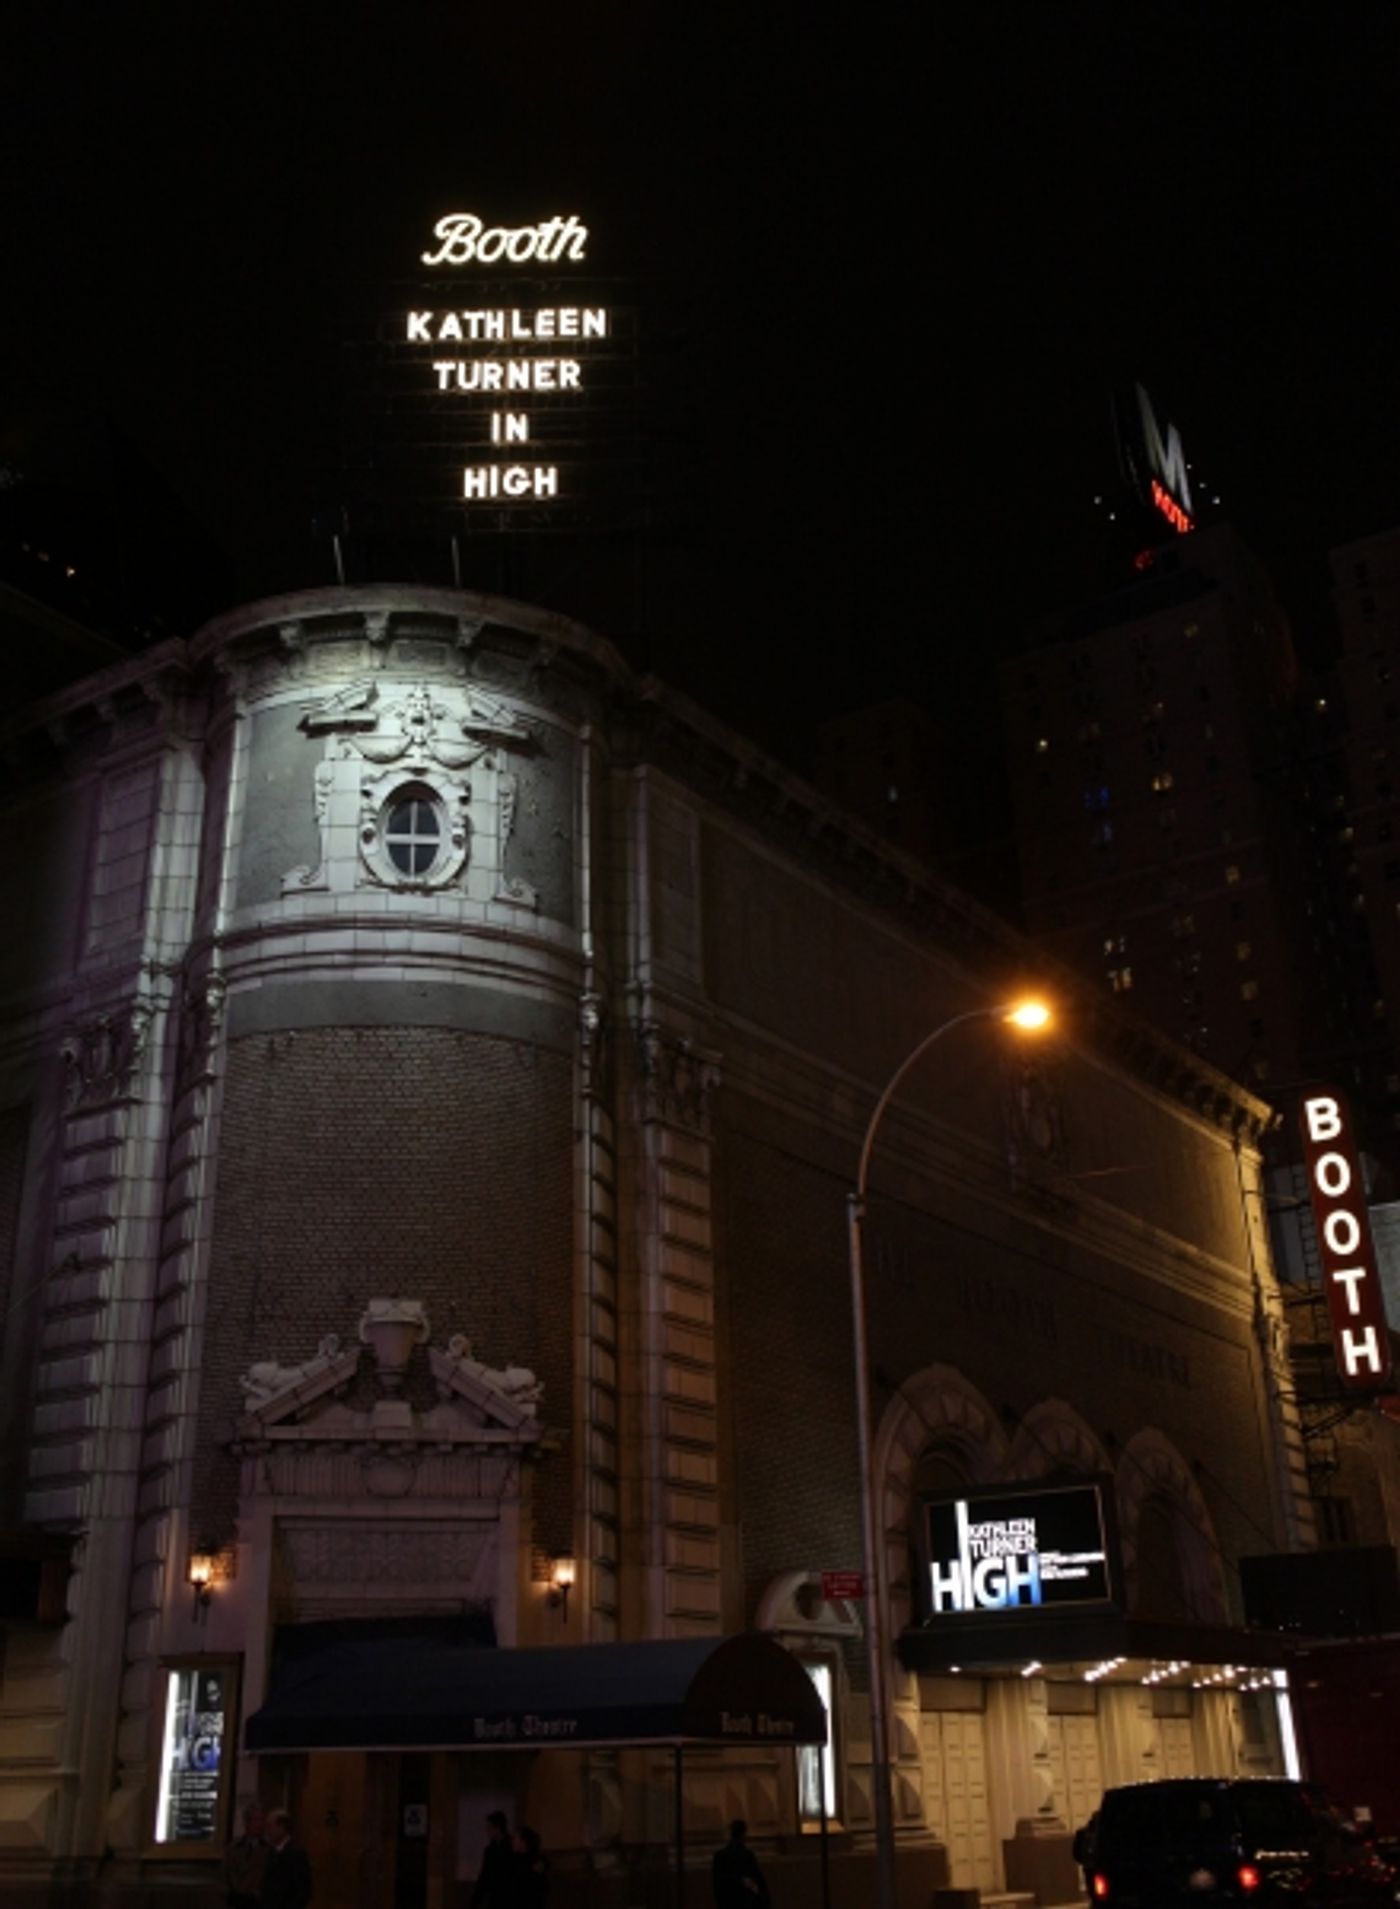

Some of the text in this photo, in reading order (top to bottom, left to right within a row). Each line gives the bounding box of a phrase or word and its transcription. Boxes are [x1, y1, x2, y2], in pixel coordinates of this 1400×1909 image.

[420, 212, 589, 266] Booth
[405, 307, 608, 342] KATHLEEN
[432, 359, 583, 392] TURNER
[489, 412, 530, 444] IN
[463, 465, 559, 500] HIGH
[1303, 1096, 1382, 1377] BOOTH
[929, 1500, 1043, 1612] HIGH
[969, 1536, 1037, 1560] TURNER
